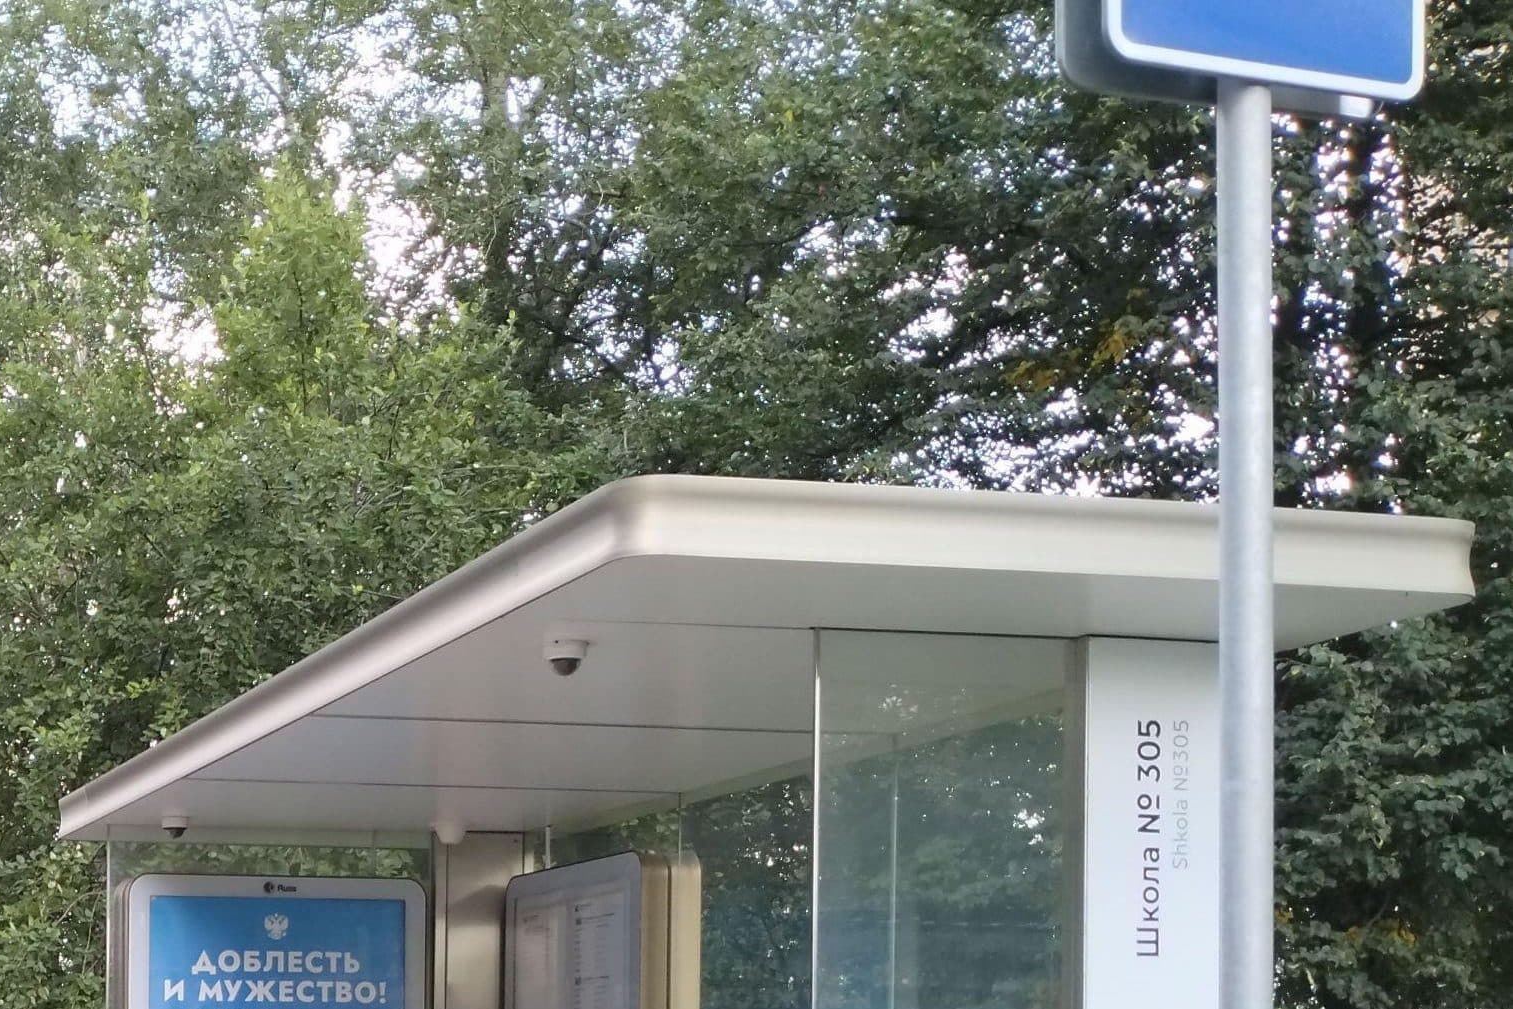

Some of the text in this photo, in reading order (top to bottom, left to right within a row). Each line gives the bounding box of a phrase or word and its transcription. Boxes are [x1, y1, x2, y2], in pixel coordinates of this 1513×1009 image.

[1137, 719, 1161, 783] 305
[1172, 799, 1189, 870] Shkola
[1136, 847, 1160, 957] Школа
[163, 979, 388, 1004] И МУЖЕСТВО!
[191, 949, 361, 976] ДОБЛЕСТЬ
